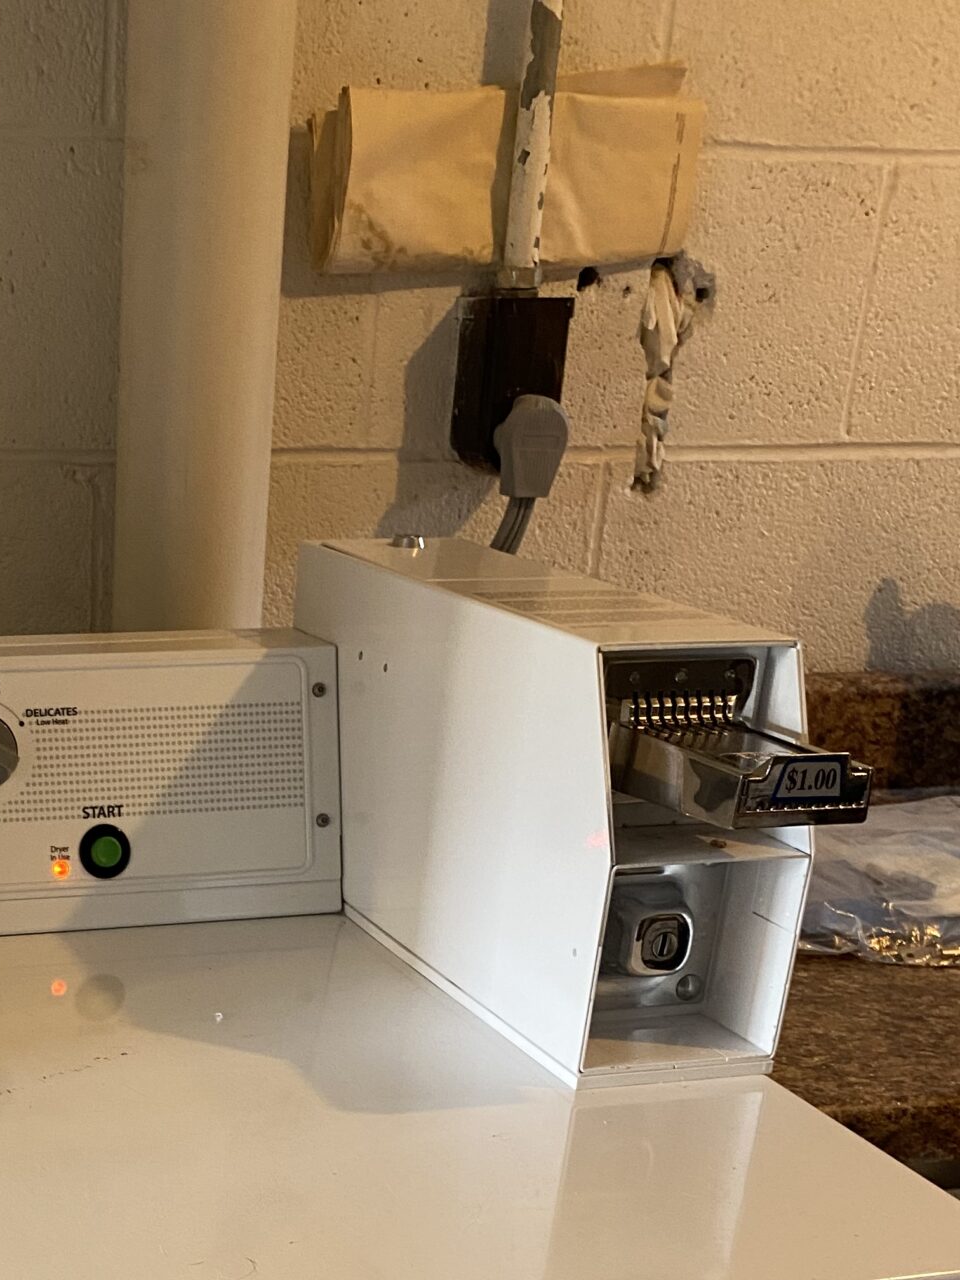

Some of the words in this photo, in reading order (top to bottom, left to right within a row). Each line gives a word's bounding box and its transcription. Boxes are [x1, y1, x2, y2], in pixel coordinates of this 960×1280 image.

[25, 707, 78, 717] DELICATES
[785, 767, 837, 793] $1.00
[82, 804, 124, 819] START
[50, 845, 69, 854] Dryer
